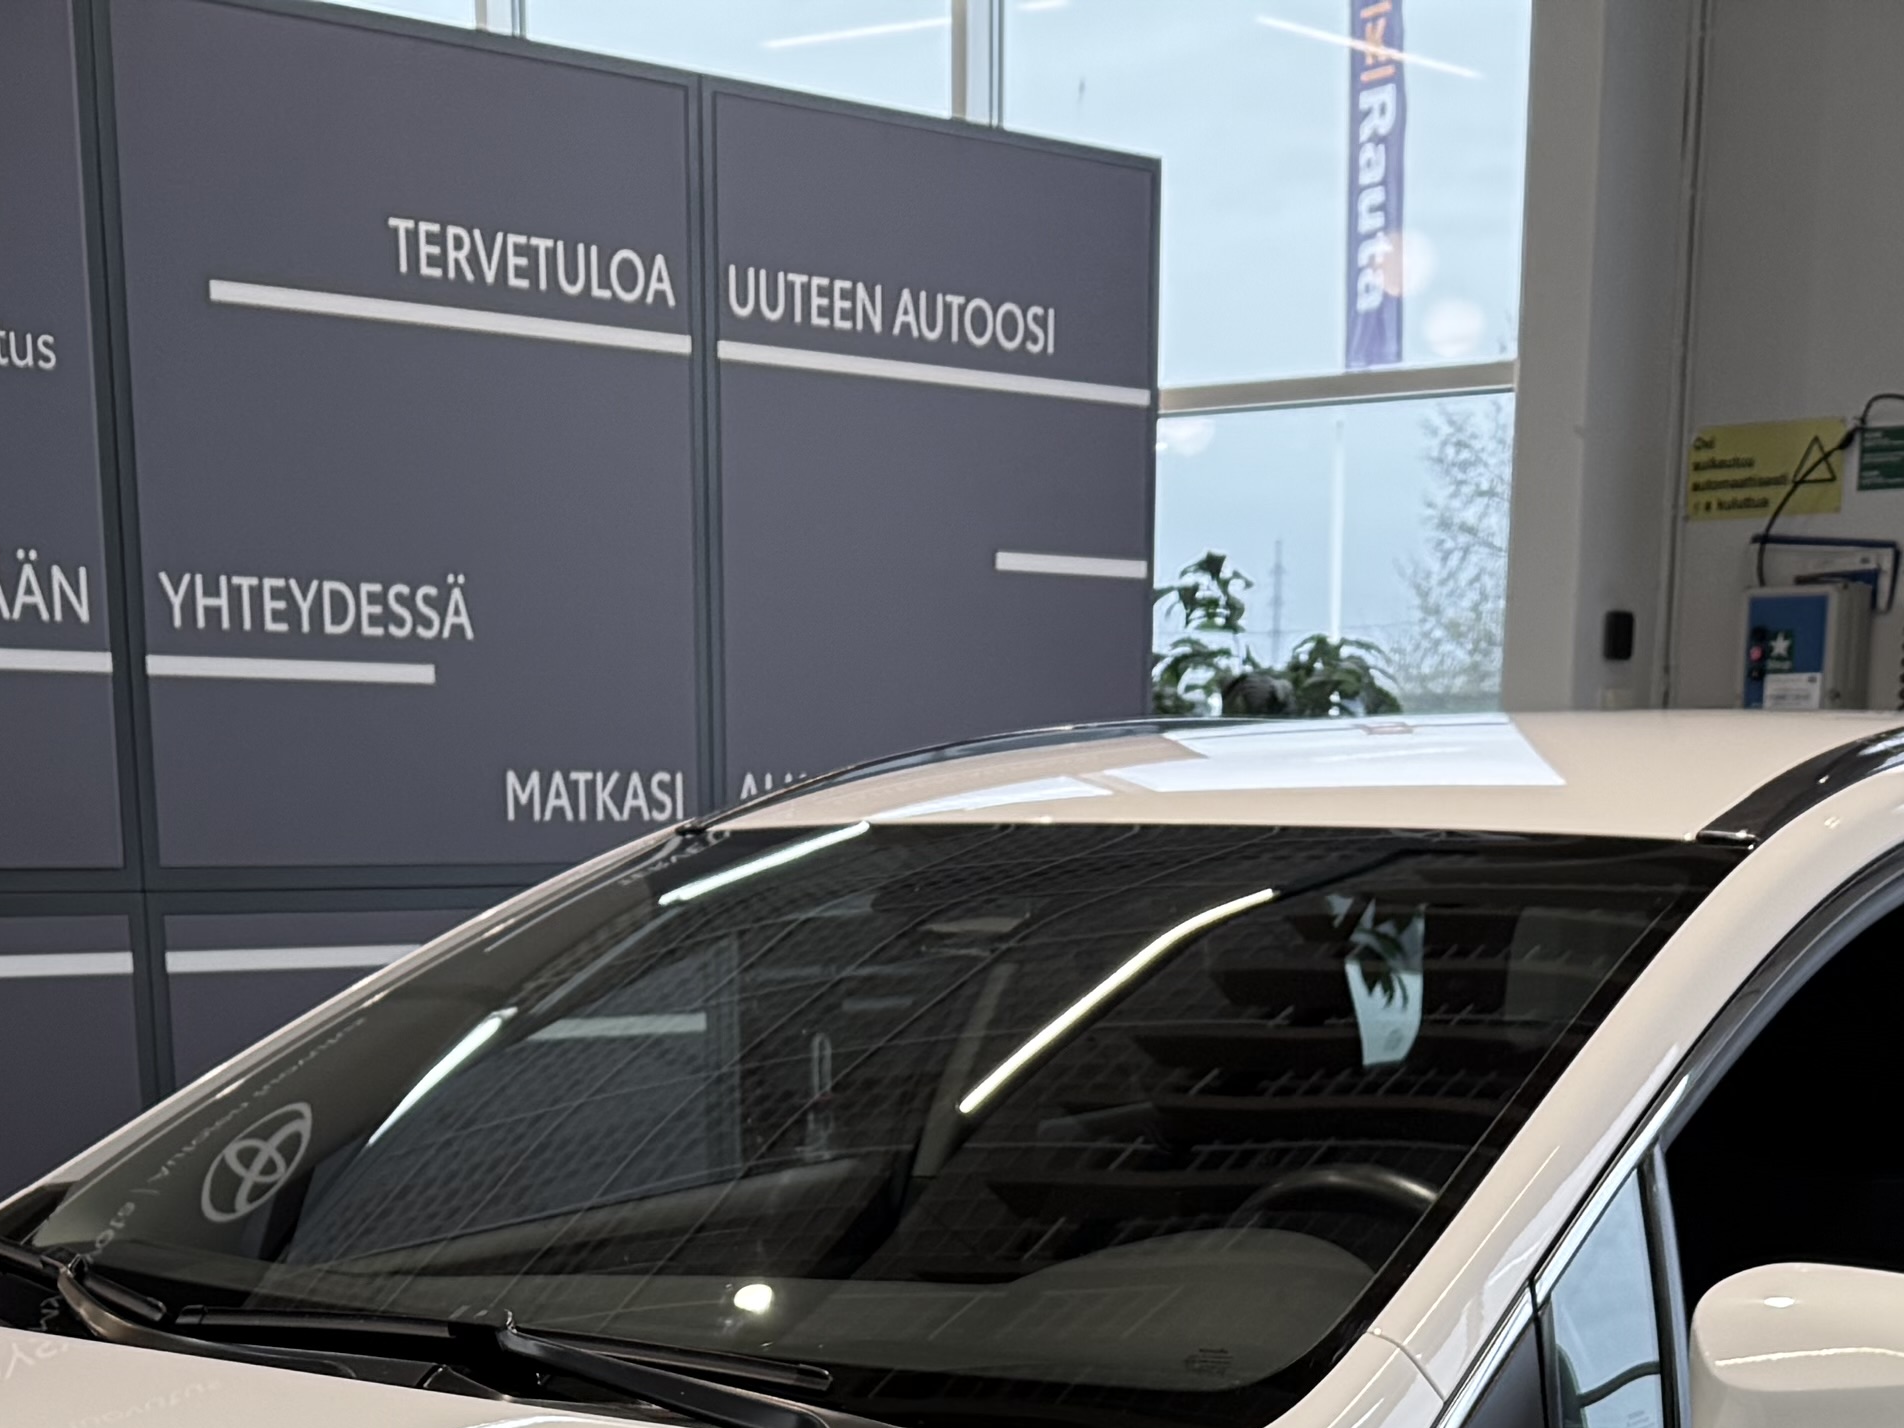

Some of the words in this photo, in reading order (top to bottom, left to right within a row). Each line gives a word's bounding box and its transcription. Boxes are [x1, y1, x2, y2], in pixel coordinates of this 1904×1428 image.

[1356, 84, 1397, 314] Rauta
[387, 216, 676, 308] TERVETULOA
[728, 264, 882, 335] UUTEEN
[892, 288, 1056, 355] AUTOOSI
[158, 571, 475, 642] YHTEYDESSÄ
[505, 769, 684, 822] MATKASI
